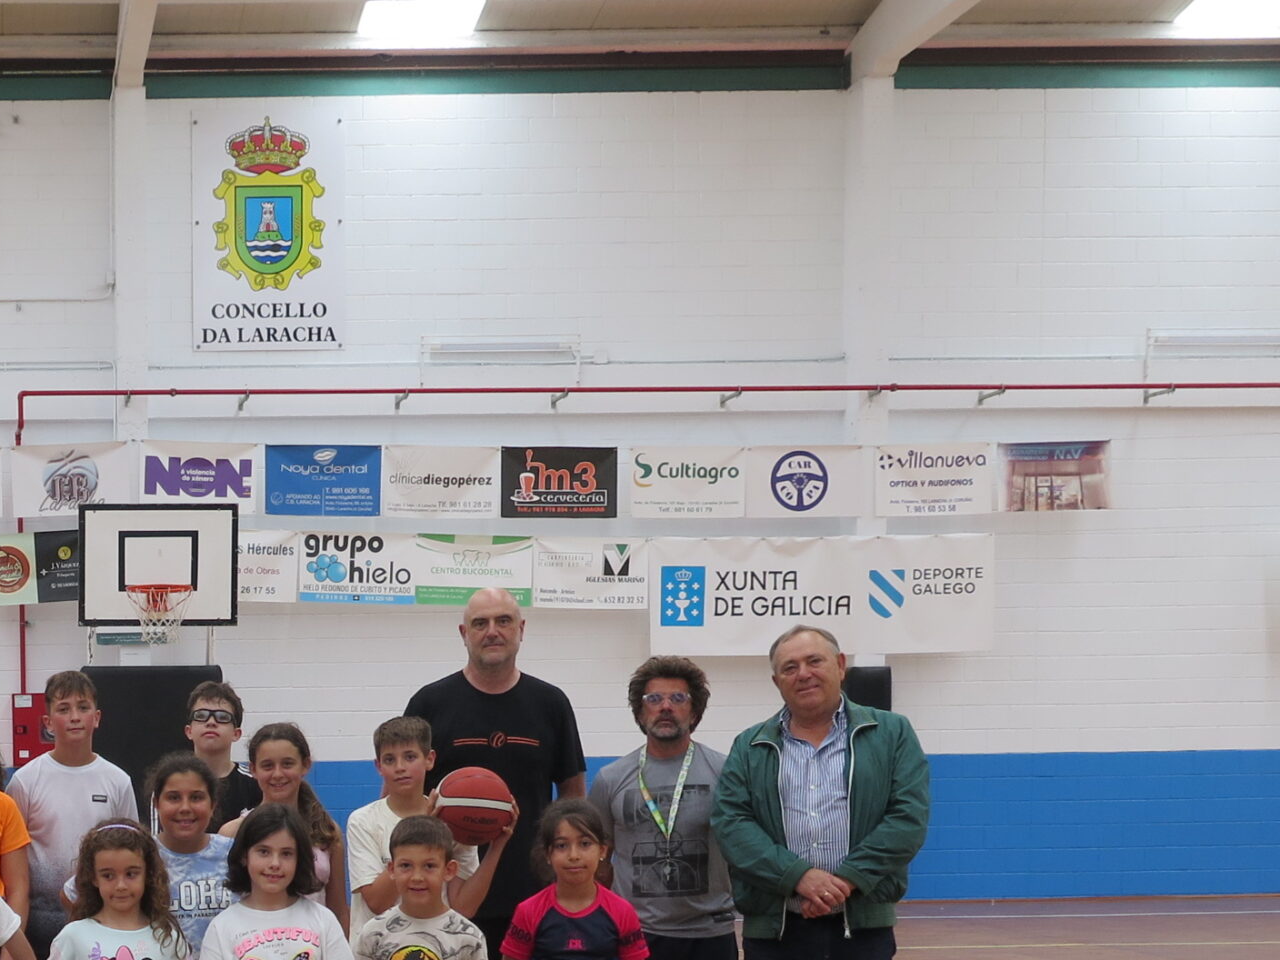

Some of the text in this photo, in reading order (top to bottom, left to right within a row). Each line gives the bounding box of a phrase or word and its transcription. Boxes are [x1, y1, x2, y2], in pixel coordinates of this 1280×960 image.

[211, 303, 327, 319] CONCELLO
[202, 326, 337, 343] DA LARACHA
[788, 460, 812, 470] CAR
[897, 450, 986, 469] villanueva
[144, 456, 252, 498] NON
[280, 464, 367, 475] Noya dental
[657, 461, 739, 484] Cultiagro
[389, 473, 492, 489] clínicadiegopérez
[889, 480, 918, 488] OPTICA
[928, 478, 973, 487] AUDIFONOS
[541, 493, 604, 503] cervecería
[780, 485, 794, 501] CO
[806, 484, 820, 499] PA
[248, 543, 294, 556] Hércules
[304, 534, 384, 558] grupo
[256, 567, 280, 575] Obras
[349, 560, 411, 584] hielo
[431, 567, 513, 576] CENTRO BUCODENTAL
[913, 566, 984, 580] DEPORTE
[716, 570, 798, 591] XUNTA
[241, 586, 251, 594] 26
[253, 586, 262, 594] 17
[321, 584, 349, 592] REDONDO
[389, 586, 411, 594] PICADO
[913, 583, 976, 595] GALEGO
[714, 595, 851, 617] DE GALICIA
[234, 927, 321, 960] BEAUTIFUL
